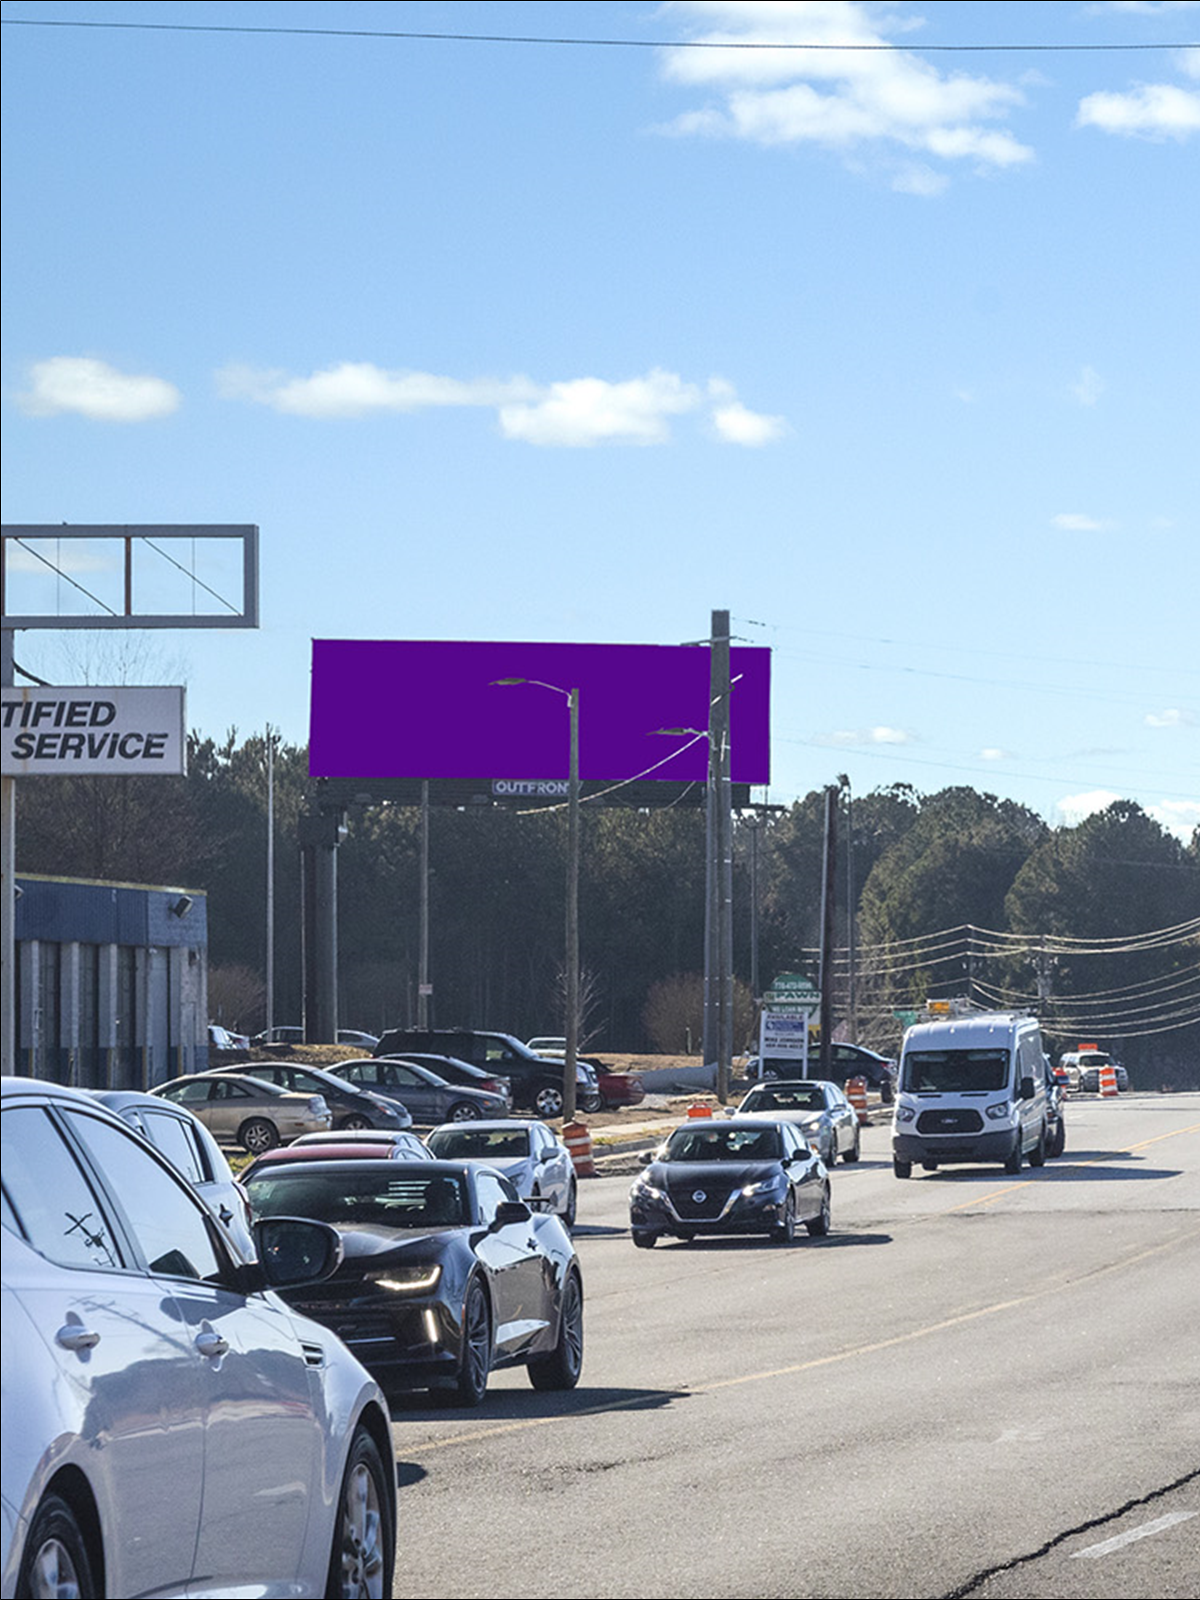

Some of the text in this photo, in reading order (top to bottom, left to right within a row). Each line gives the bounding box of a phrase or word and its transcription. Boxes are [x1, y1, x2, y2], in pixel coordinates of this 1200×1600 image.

[2, 701, 117, 728] TIFIED
[11, 732, 169, 760] SERVICE
[495, 781, 571, 794] OUTFRON
